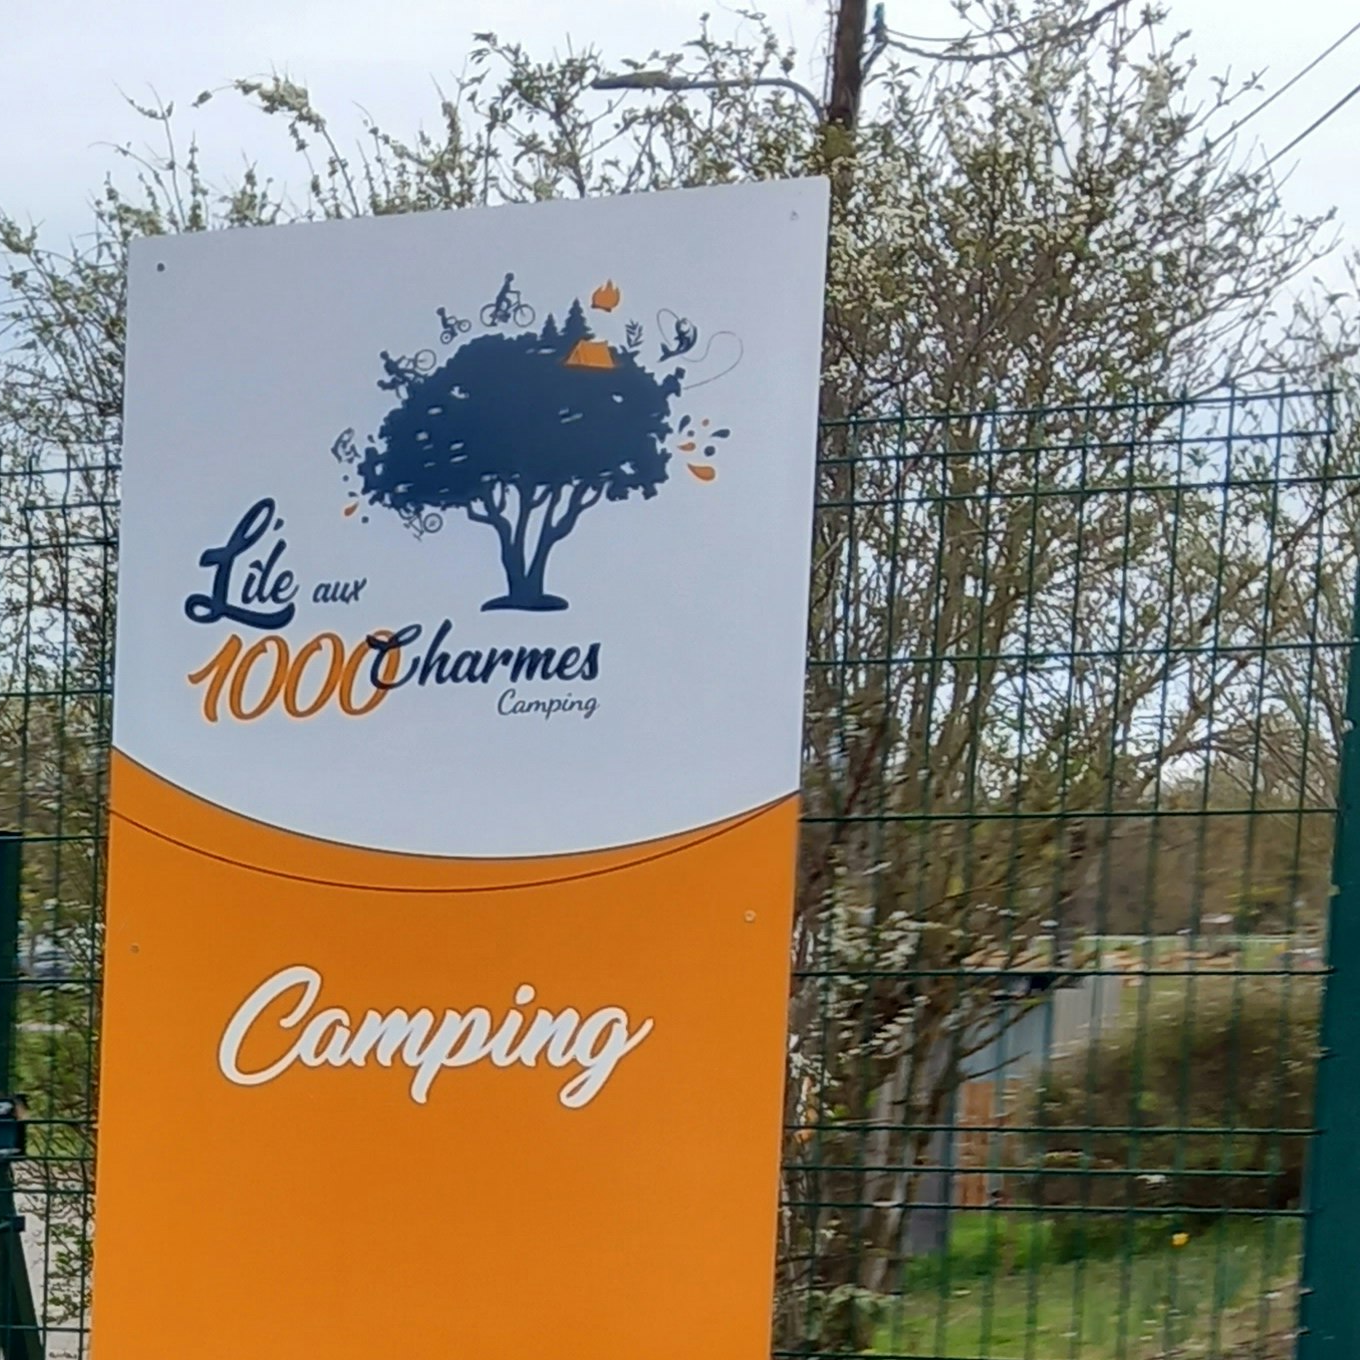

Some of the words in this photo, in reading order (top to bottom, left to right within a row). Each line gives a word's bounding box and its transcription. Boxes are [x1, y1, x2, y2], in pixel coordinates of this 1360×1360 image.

[311, 577, 368, 605] aux
[187, 628, 401, 723] 1000
[366, 618, 602, 691] Charmes
[497, 688, 601, 720] Camping
[218, 964, 655, 1109] Camping
